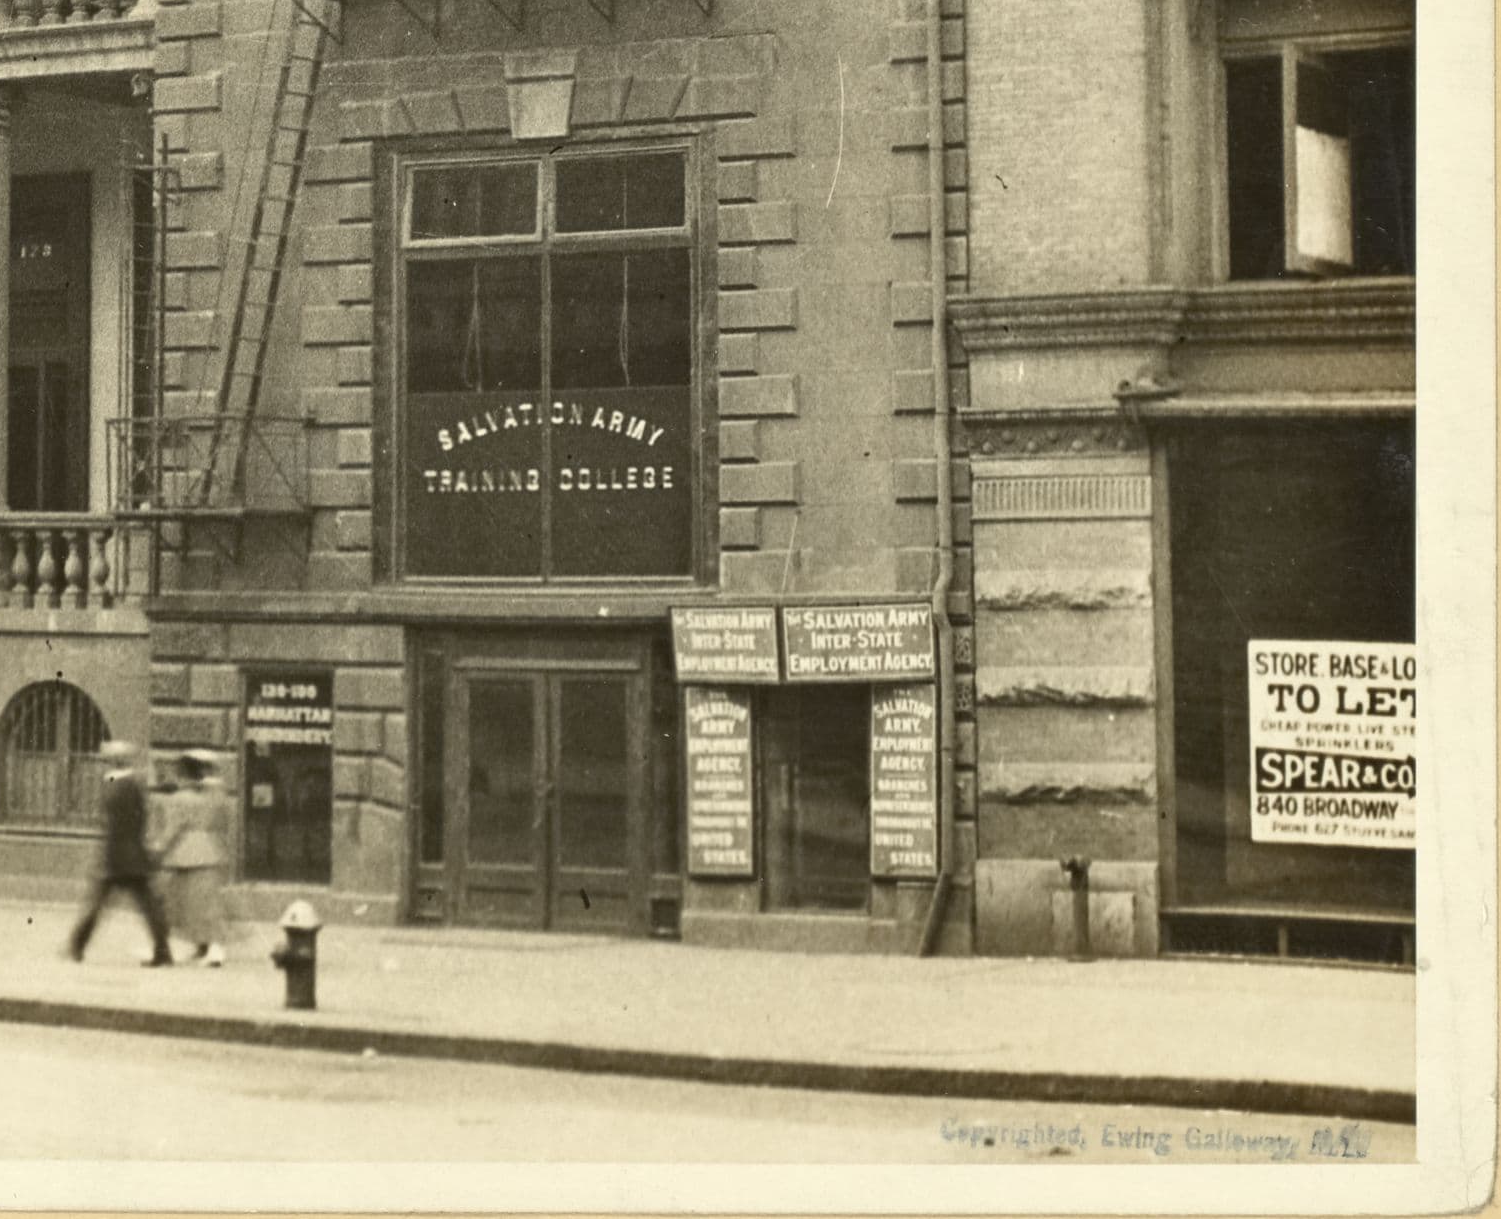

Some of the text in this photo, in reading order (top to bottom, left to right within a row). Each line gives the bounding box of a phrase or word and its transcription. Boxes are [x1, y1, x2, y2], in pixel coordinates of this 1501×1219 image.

[438, 402, 665, 451] SALVATION ARMY
[424, 466, 674, 492] TRAINING COLLEGE
[803, 611, 885, 630] SALVATION
[888, 609, 929, 627] ARMY
[790, 653, 882, 673] EMPLOYMENT
[1268, 684, 1321, 714] TO
[1295, 736, 1395, 753] SPRINKLERS
[1256, 795, 1298, 816] 840
[1303, 796, 1399, 820] BROADWAY
